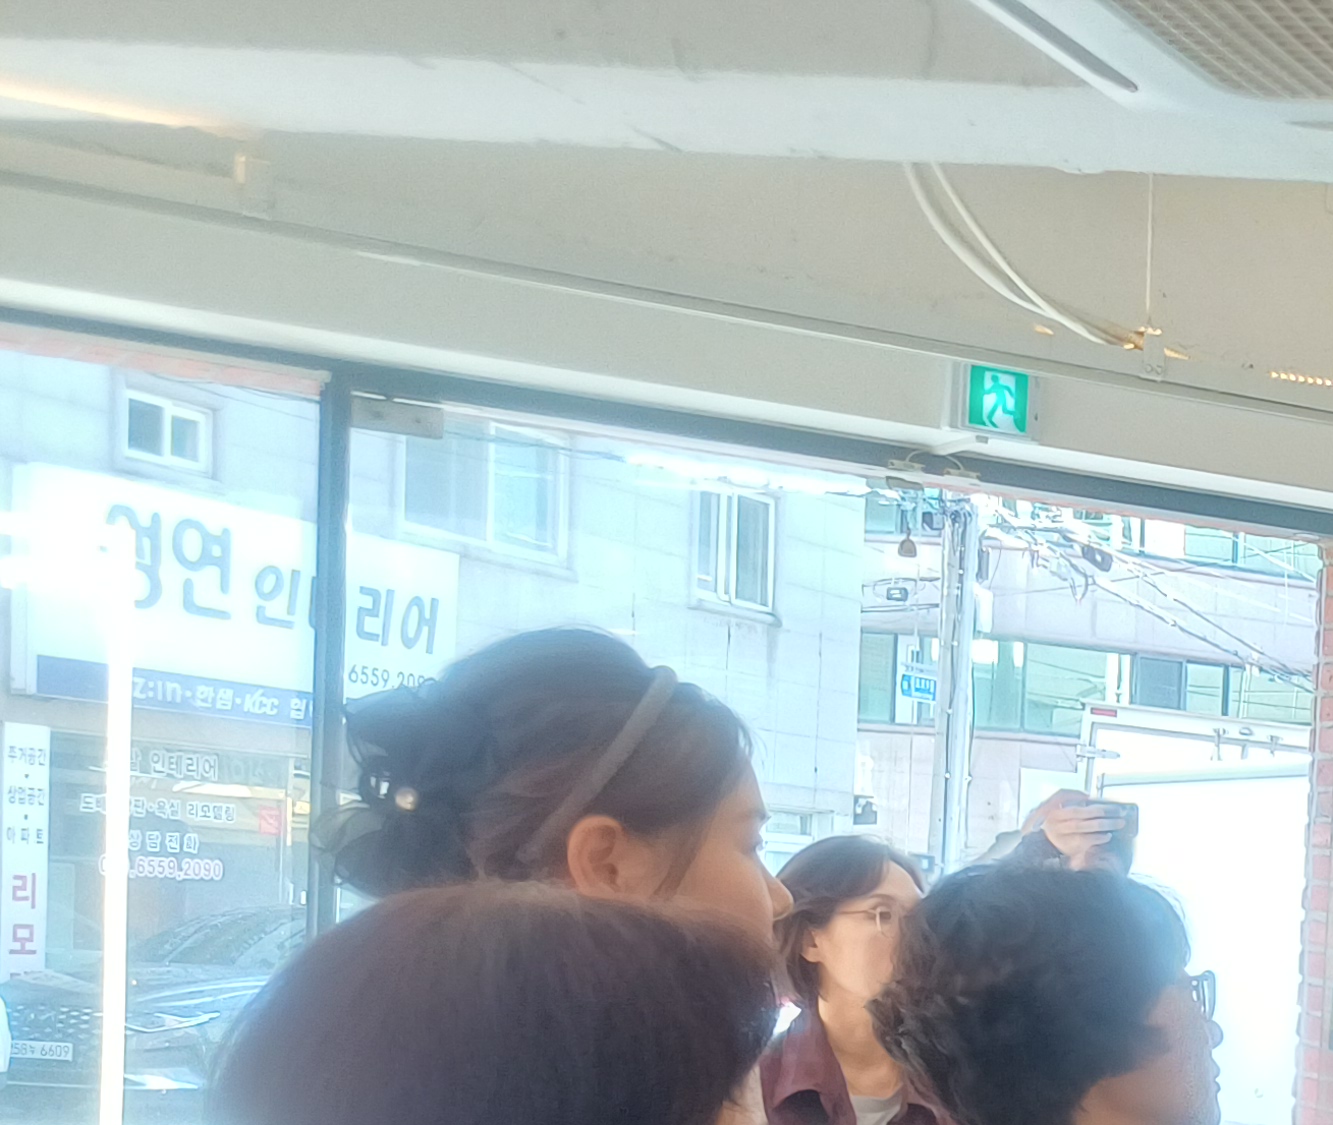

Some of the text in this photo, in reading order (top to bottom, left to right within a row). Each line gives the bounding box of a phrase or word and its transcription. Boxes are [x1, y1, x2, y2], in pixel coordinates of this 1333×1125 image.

[255, 565, 440, 654] 인리어
[8, 745, 46, 767] 주거공간
[151, 750, 218, 781] 인테리어
[8, 785, 46, 807] 상업공간
[186, 800, 236, 824] 리모델링
[6, 825, 45, 845] 아파트
[100, 854, 223, 880] .6559.2090
[40, 1044, 70, 1058] 6609
